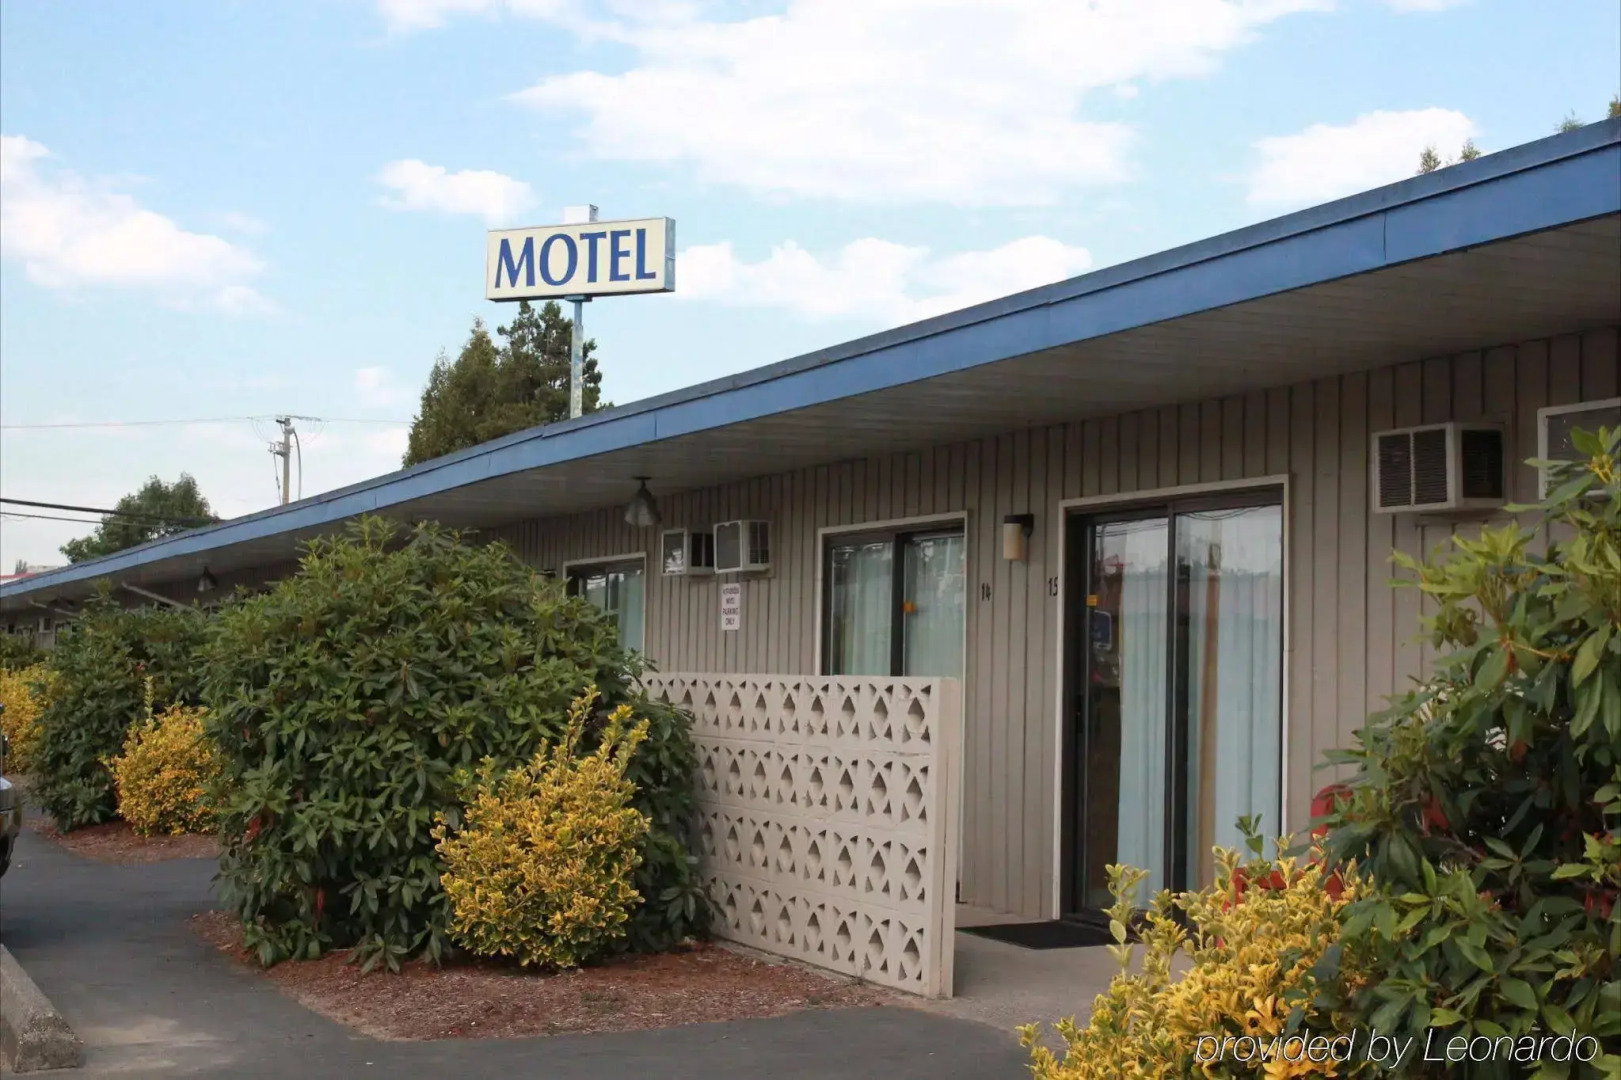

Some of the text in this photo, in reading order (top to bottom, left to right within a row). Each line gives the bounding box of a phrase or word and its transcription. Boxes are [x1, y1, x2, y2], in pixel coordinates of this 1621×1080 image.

[494, 228, 657, 289] MOTEL
[981, 582, 991, 601] 14
[1048, 576, 1059, 597] 15
